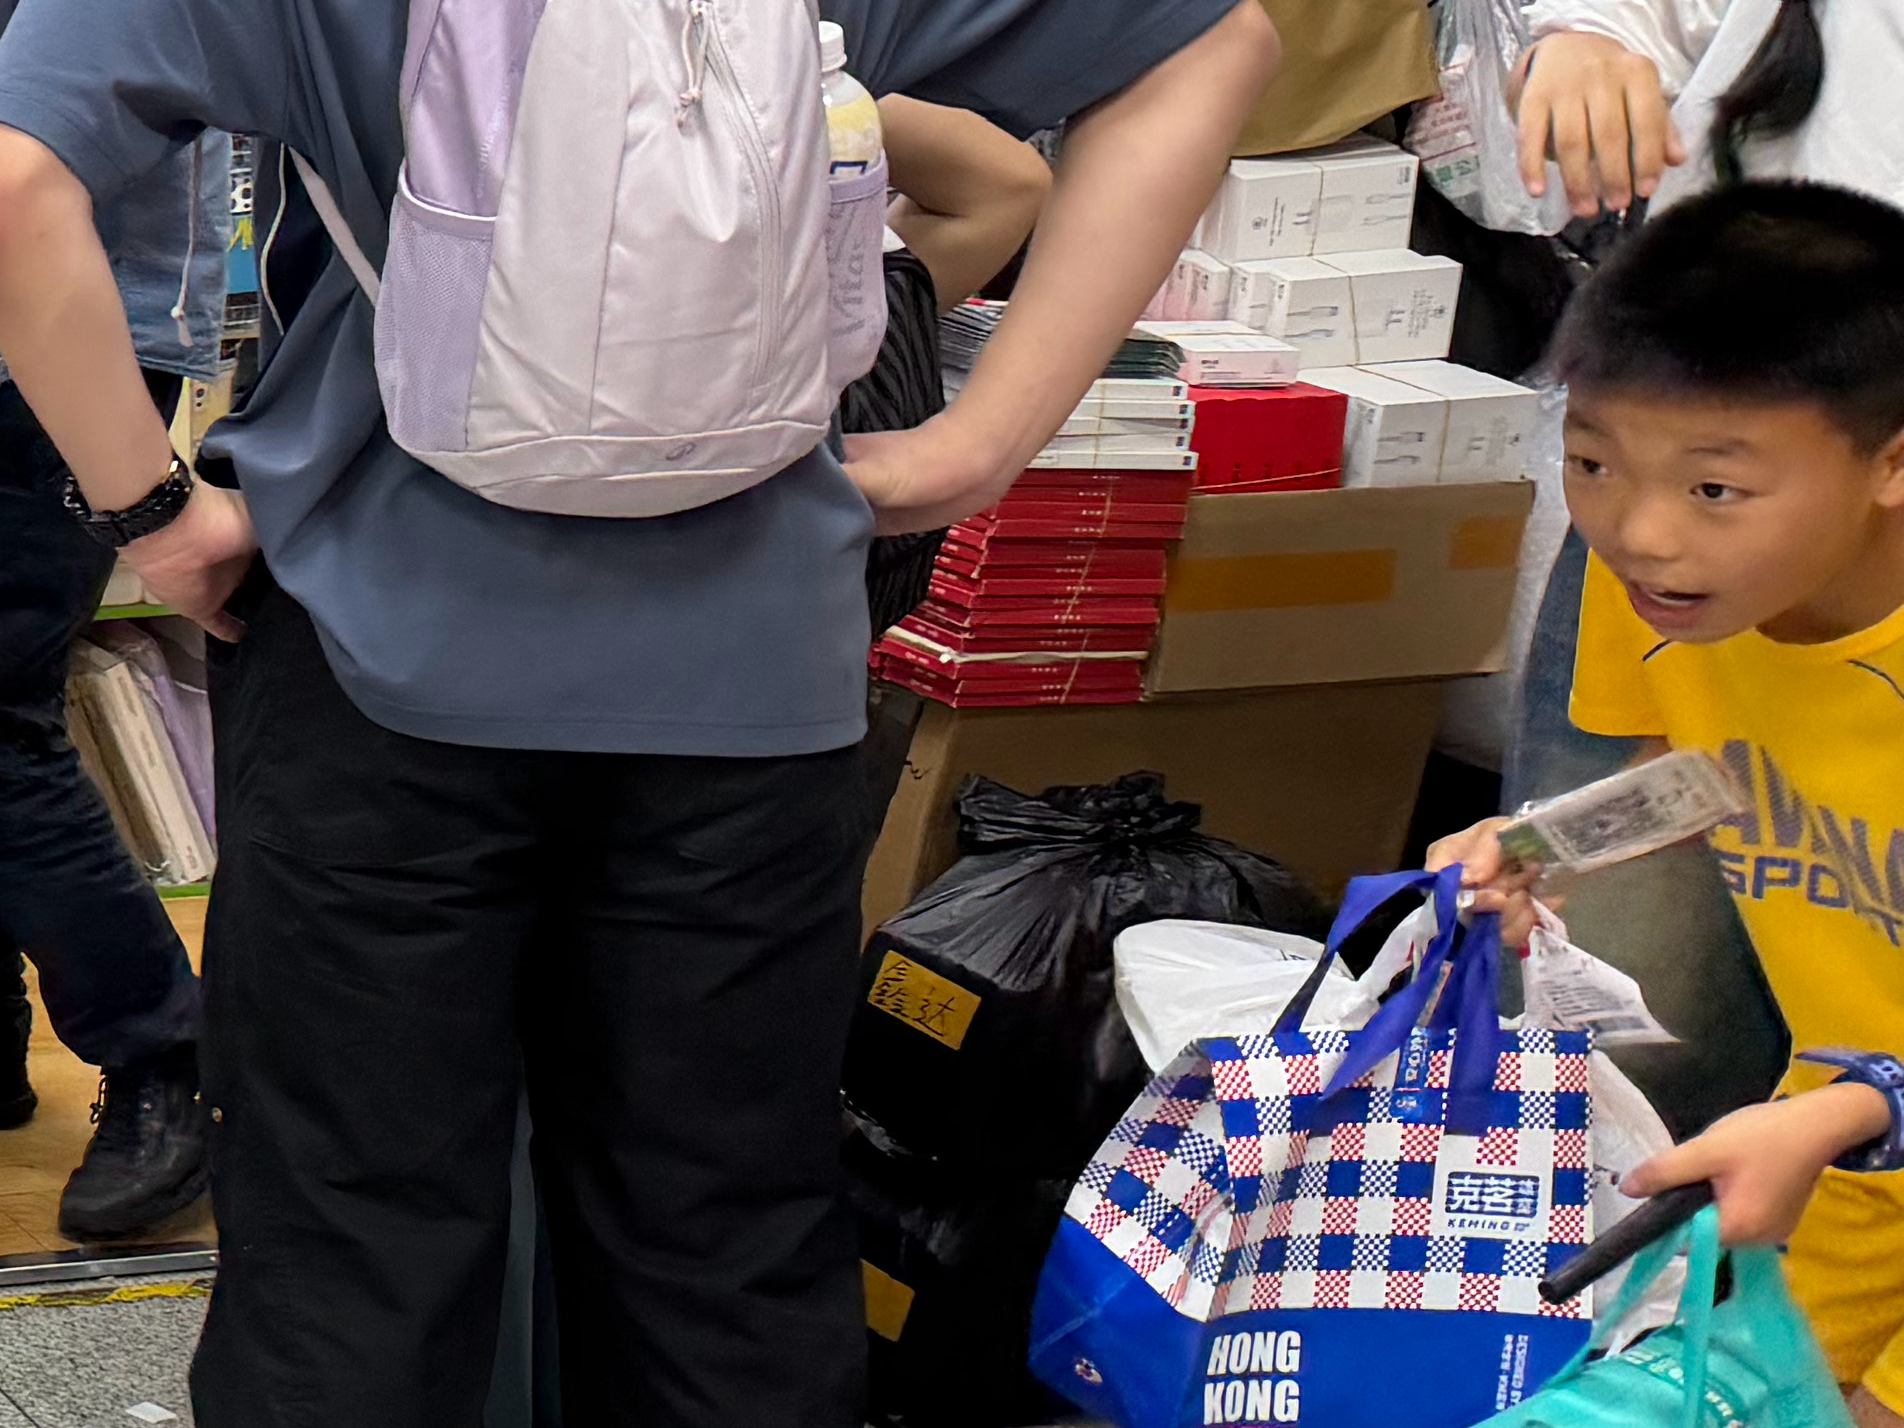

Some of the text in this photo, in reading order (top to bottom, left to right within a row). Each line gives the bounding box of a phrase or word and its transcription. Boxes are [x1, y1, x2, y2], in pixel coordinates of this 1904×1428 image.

[1448, 1219, 1510, 1232] KEMING
[1206, 1329, 1302, 1376] HONG
[1203, 1378, 1301, 1426] KONG
